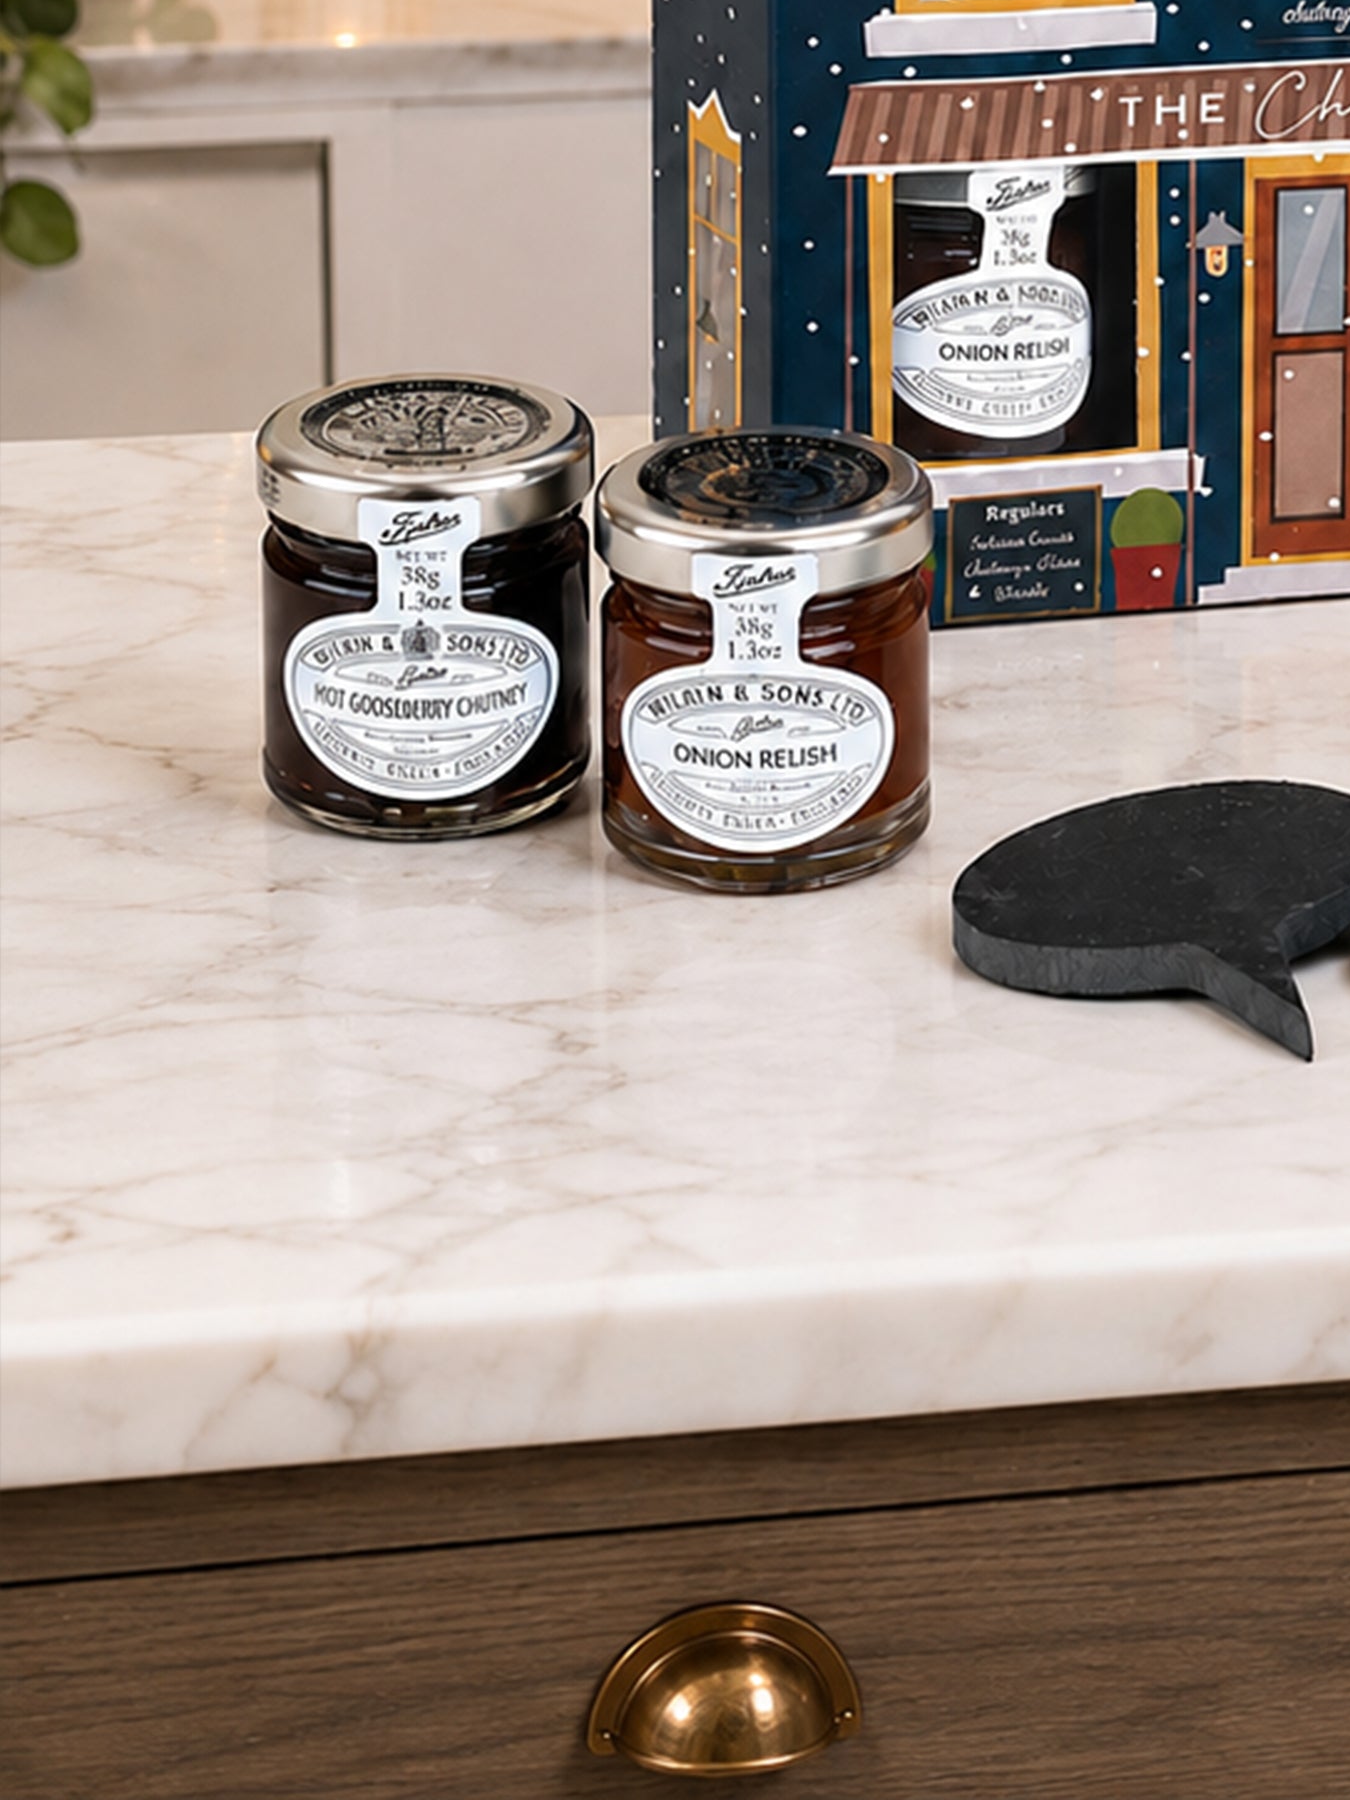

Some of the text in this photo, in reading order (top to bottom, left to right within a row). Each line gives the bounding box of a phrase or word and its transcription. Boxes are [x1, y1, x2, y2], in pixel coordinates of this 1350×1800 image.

[1118, 92, 1225, 128] THE
[939, 341, 1009, 362] ONION
[760, 682, 824, 707] SONS
[829, 699, 866, 722] LTD
[672, 742, 838, 770] ONION RELISH
